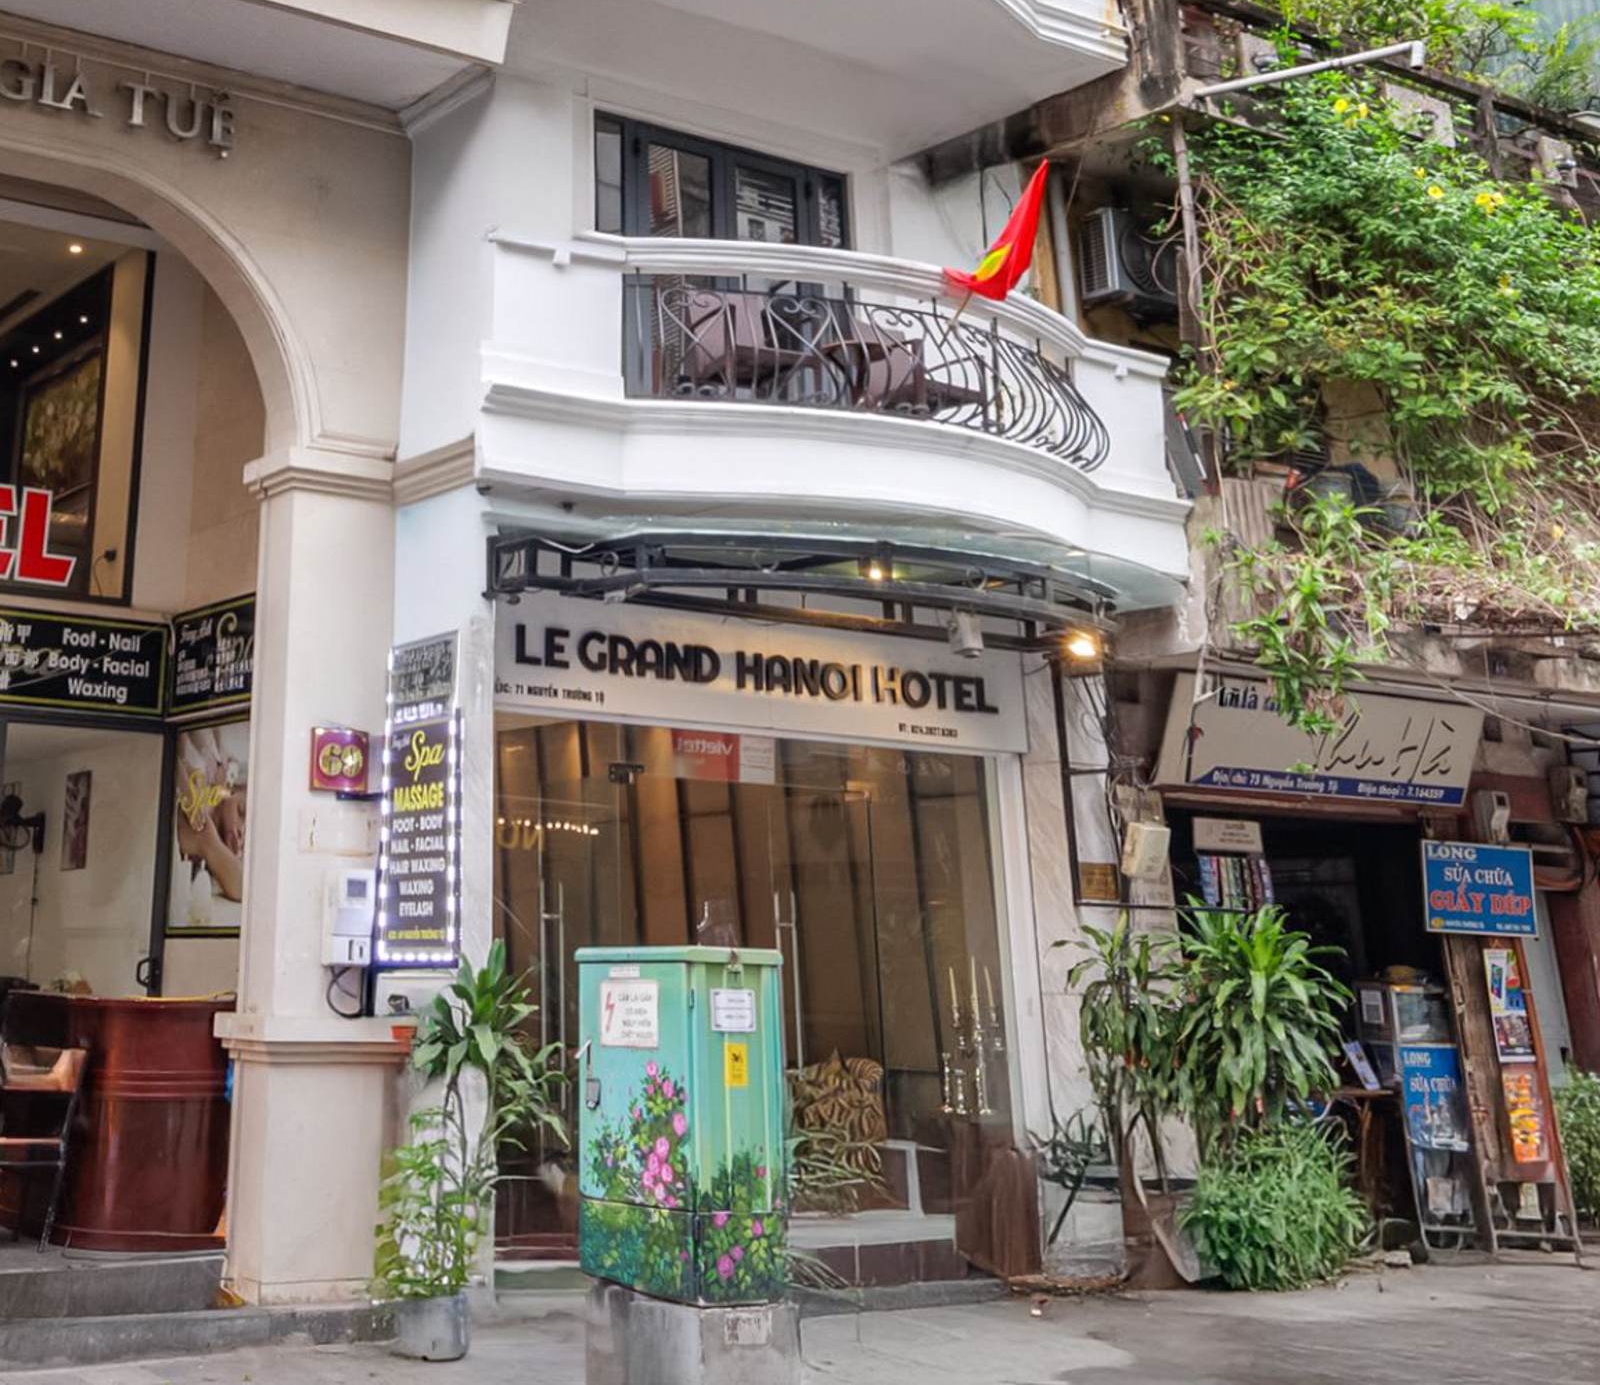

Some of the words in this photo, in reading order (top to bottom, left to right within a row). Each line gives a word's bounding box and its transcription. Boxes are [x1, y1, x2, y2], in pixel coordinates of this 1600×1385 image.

[0, 59, 104, 117] GIA
[62, 627, 96, 648] Foot
[108, 632, 141, 653] Nail
[48, 649, 90, 675] Body
[102, 656, 150, 678] Facial
[67, 677, 128, 703] Waxing
[735, 651, 862, 702] HANOI
[873, 665, 999, 715] HOTEL
[319, 743, 363, 777] 69
[404, 729, 446, 782] Spa
[393, 781, 445, 812] MASSAGE
[392, 817, 415, 833] FOOT
[420, 814, 443, 830] BODY
[390, 838, 409, 855] NAIL
[415, 835, 445, 852] FACIAL
[1427, 845, 1477, 860] LONG
[399, 879, 433, 897] WAXING
[399, 901, 434, 918] EYELASH
